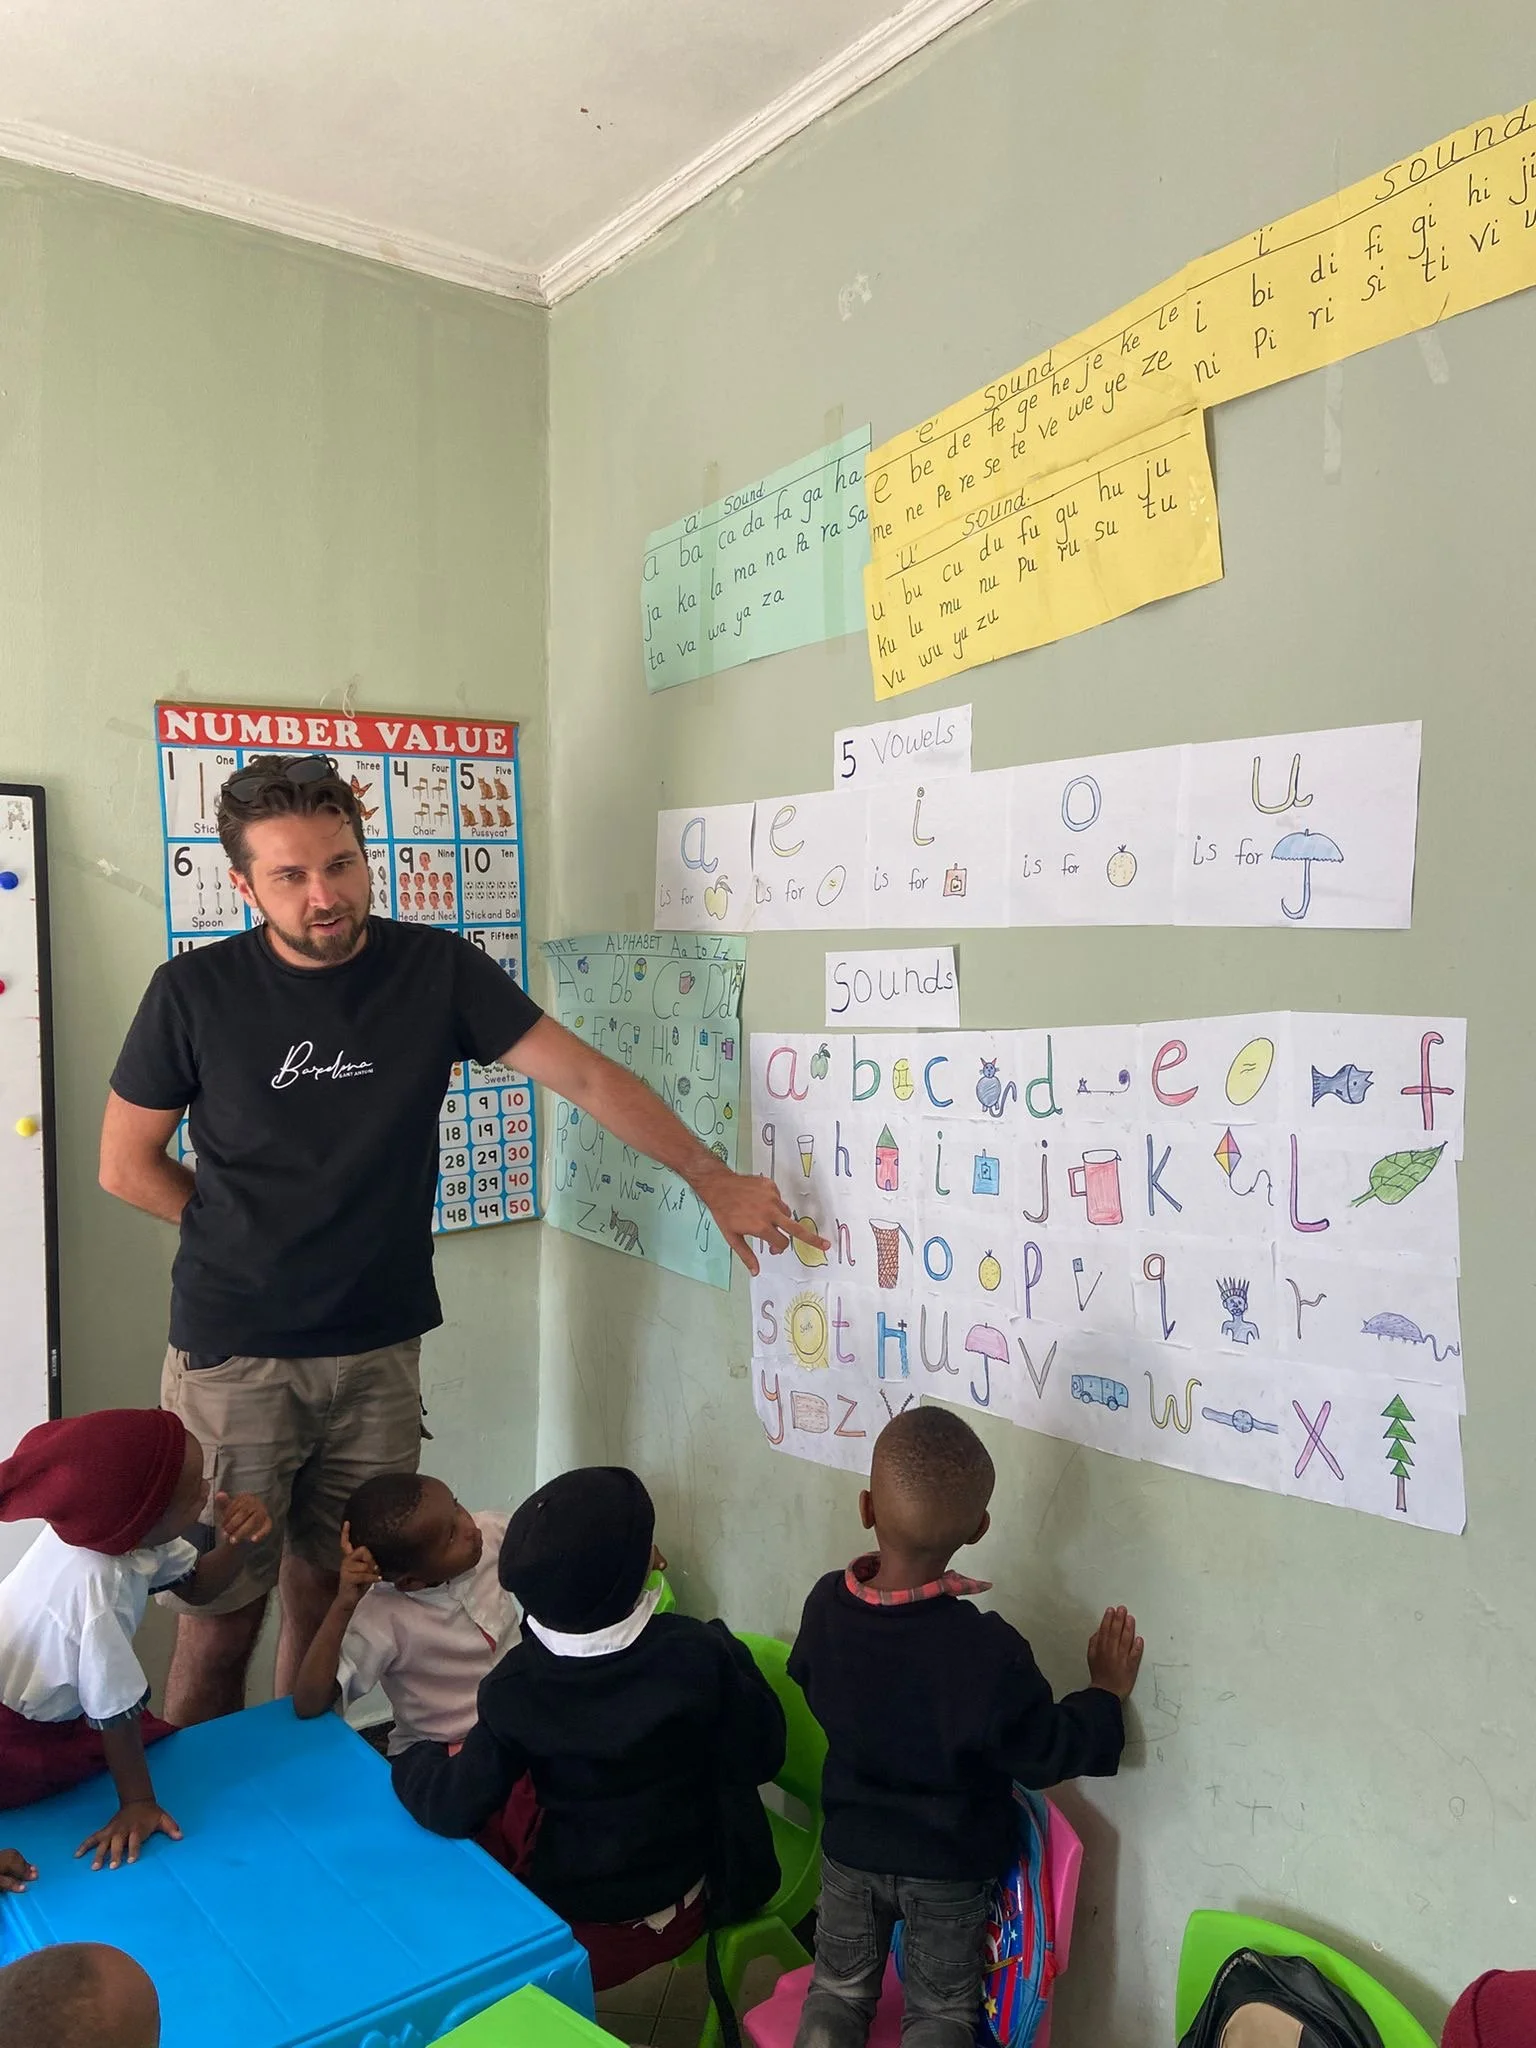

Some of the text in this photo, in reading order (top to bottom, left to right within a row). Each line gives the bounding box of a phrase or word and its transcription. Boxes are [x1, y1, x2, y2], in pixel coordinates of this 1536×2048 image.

[1195, 151, 1536, 333] i bi di fi gi hi ji
[1194, 245, 1450, 383] ni ri si ti
[874, 306, 1179, 504] e be de fe ge he je ke le
[872, 350, 1173, 544] me ne re se te ve we ye ze
[642, 459, 862, 581] a ba ca da fa ga ha
[902, 577, 923, 605] bu
[942, 561, 965, 583] cu
[978, 534, 1004, 562] du
[1016, 515, 1041, 547] fu
[1055, 500, 1079, 545] gu
[1097, 471, 1125, 502] hu
[1137, 457, 1172, 500] ju
[908, 615, 925, 639] lu
[939, 597, 962, 618] mu
[979, 575, 1000, 594] nu
[1058, 539, 1081, 563] ru
[1094, 518, 1120, 542] su
[1141, 495, 1178, 520] tu
[644, 523, 841, 641] ja ka la ma na ra
[648, 589, 785, 670] ta va wa ya za
[917, 608, 1000, 668] wu yu zu
[164, 709, 508, 755] NUMBER VALUE
[215, 755, 235, 766] One
[356, 760, 381, 771] Three
[841, 739, 857, 779] 5
[393, 760, 450, 788] 4 Four
[459, 763, 512, 791] 5 Five
[413, 826, 437, 837] Chair
[471, 827, 509, 839] Pussycat
[680, 817, 719, 873] a
[769, 804, 805, 858] e
[912, 786, 935, 847] i
[174, 846, 193, 877] 6
[364, 848, 385, 860] Eight
[399, 847, 455, 874] 9 Nine
[463, 847, 515, 874] 10 Ten
[1192, 835, 1265, 866] is for
[873, 866, 929, 891] is for
[1022, 853, 1080, 878] is for
[659, 885, 695, 908] is for
[754, 877, 805, 905] is for
[191, 917, 224, 930] Spoon
[398, 911, 457, 922] Head and Neck
[465, 910, 487, 920] Stick
[487, 910, 502, 919] and
[490, 931, 518, 940] Fifteen
[543, 938, 579, 955] THE
[605, 934, 663, 953] ALPHABET
[670, 936, 687, 958] Aa
[694, 936, 707, 960] to
[558, 956, 595, 1003] Aa
[609, 954, 633, 1004] Bb
[702, 962, 733, 1019] Dd
[830, 958, 954, 1013] Sounds
[651, 1024, 673, 1066] Hh
[484, 1073, 515, 1085] Sweets
[766, 1030, 1455, 1131] a b d e f
[446, 1093, 524, 1114] 8 9 10
[445, 1119, 528, 1141] 18 19 20
[444, 1146, 529, 1169] 28 29 30
[446, 1172, 529, 1197] 38 39 40
[835, 1120, 1049, 1225] h i j
[446, 1199, 530, 1223] 48 49 50
[835, 1218, 856, 1267] n
[1142, 1251, 1176, 1341] q
[831, 1296, 856, 1364] t
